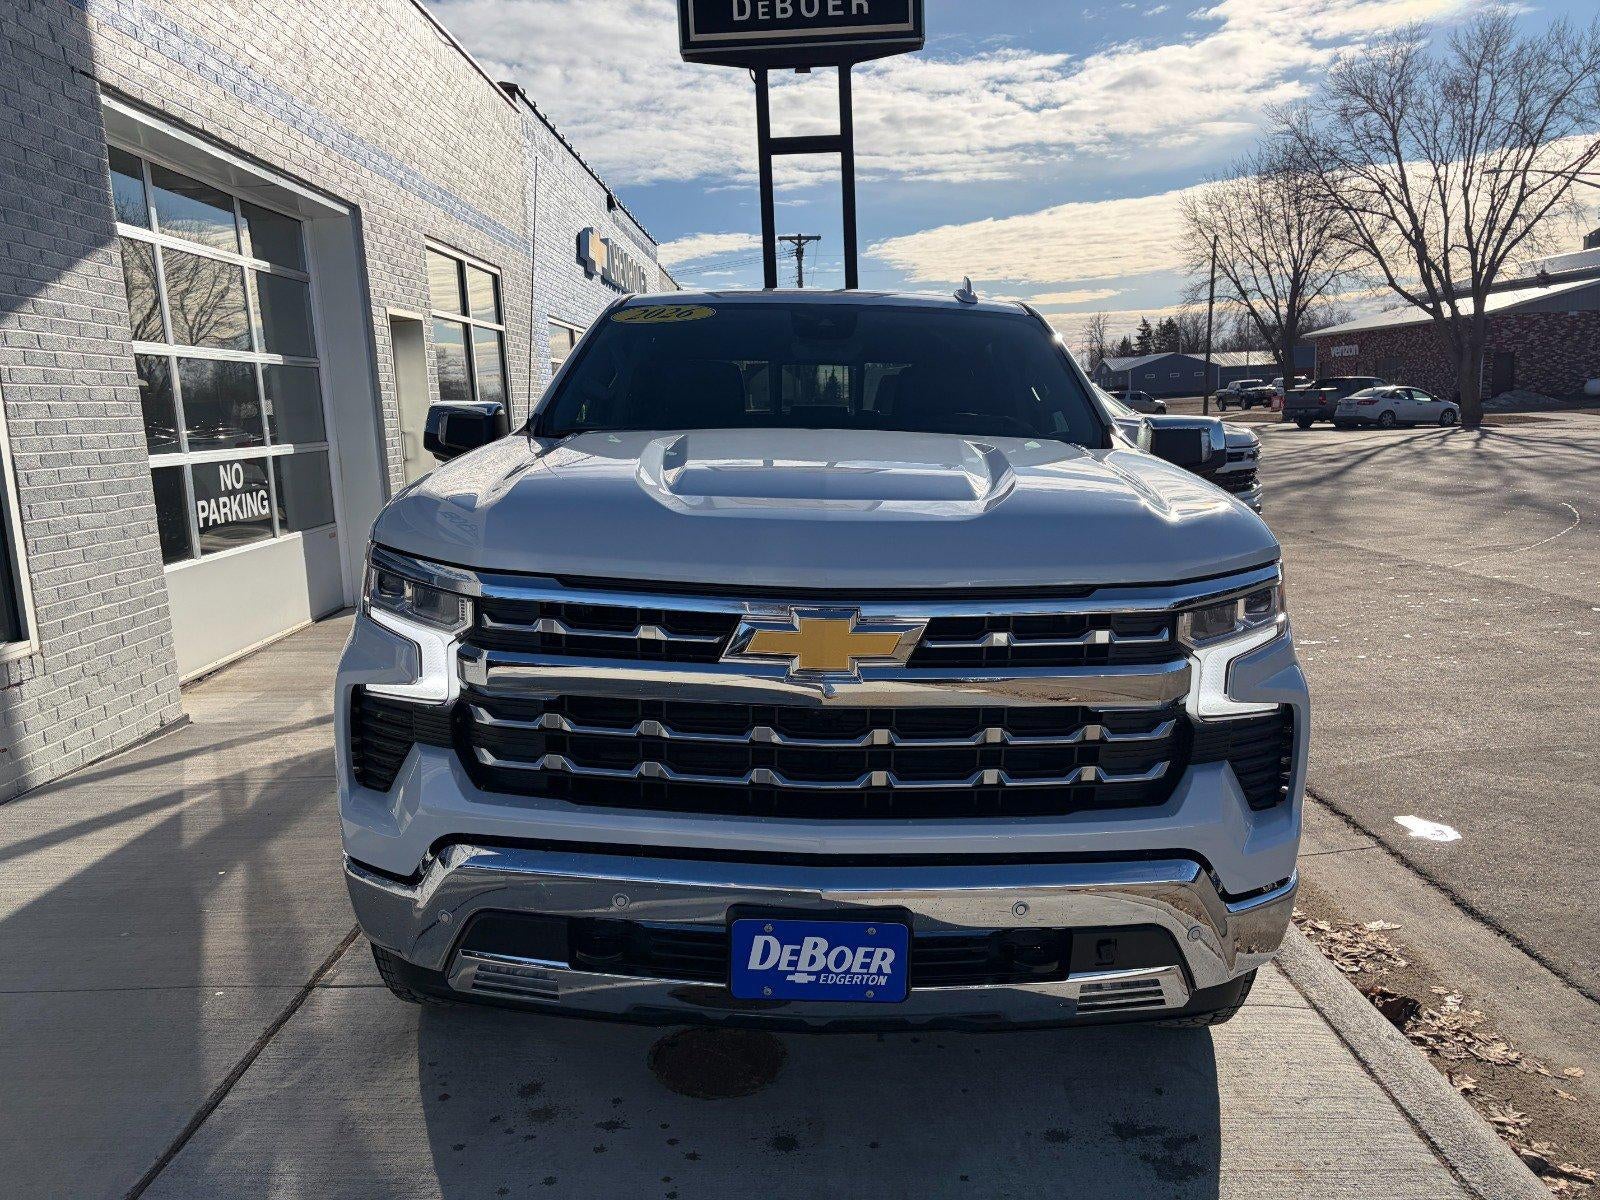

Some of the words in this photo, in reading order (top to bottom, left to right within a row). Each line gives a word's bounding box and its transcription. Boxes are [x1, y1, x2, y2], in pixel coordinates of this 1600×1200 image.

[624, 307, 695, 321] 2026
[219, 462, 244, 491] NO
[197, 489, 270, 528] PARKING
[819, 973, 888, 986] EDGERTON
